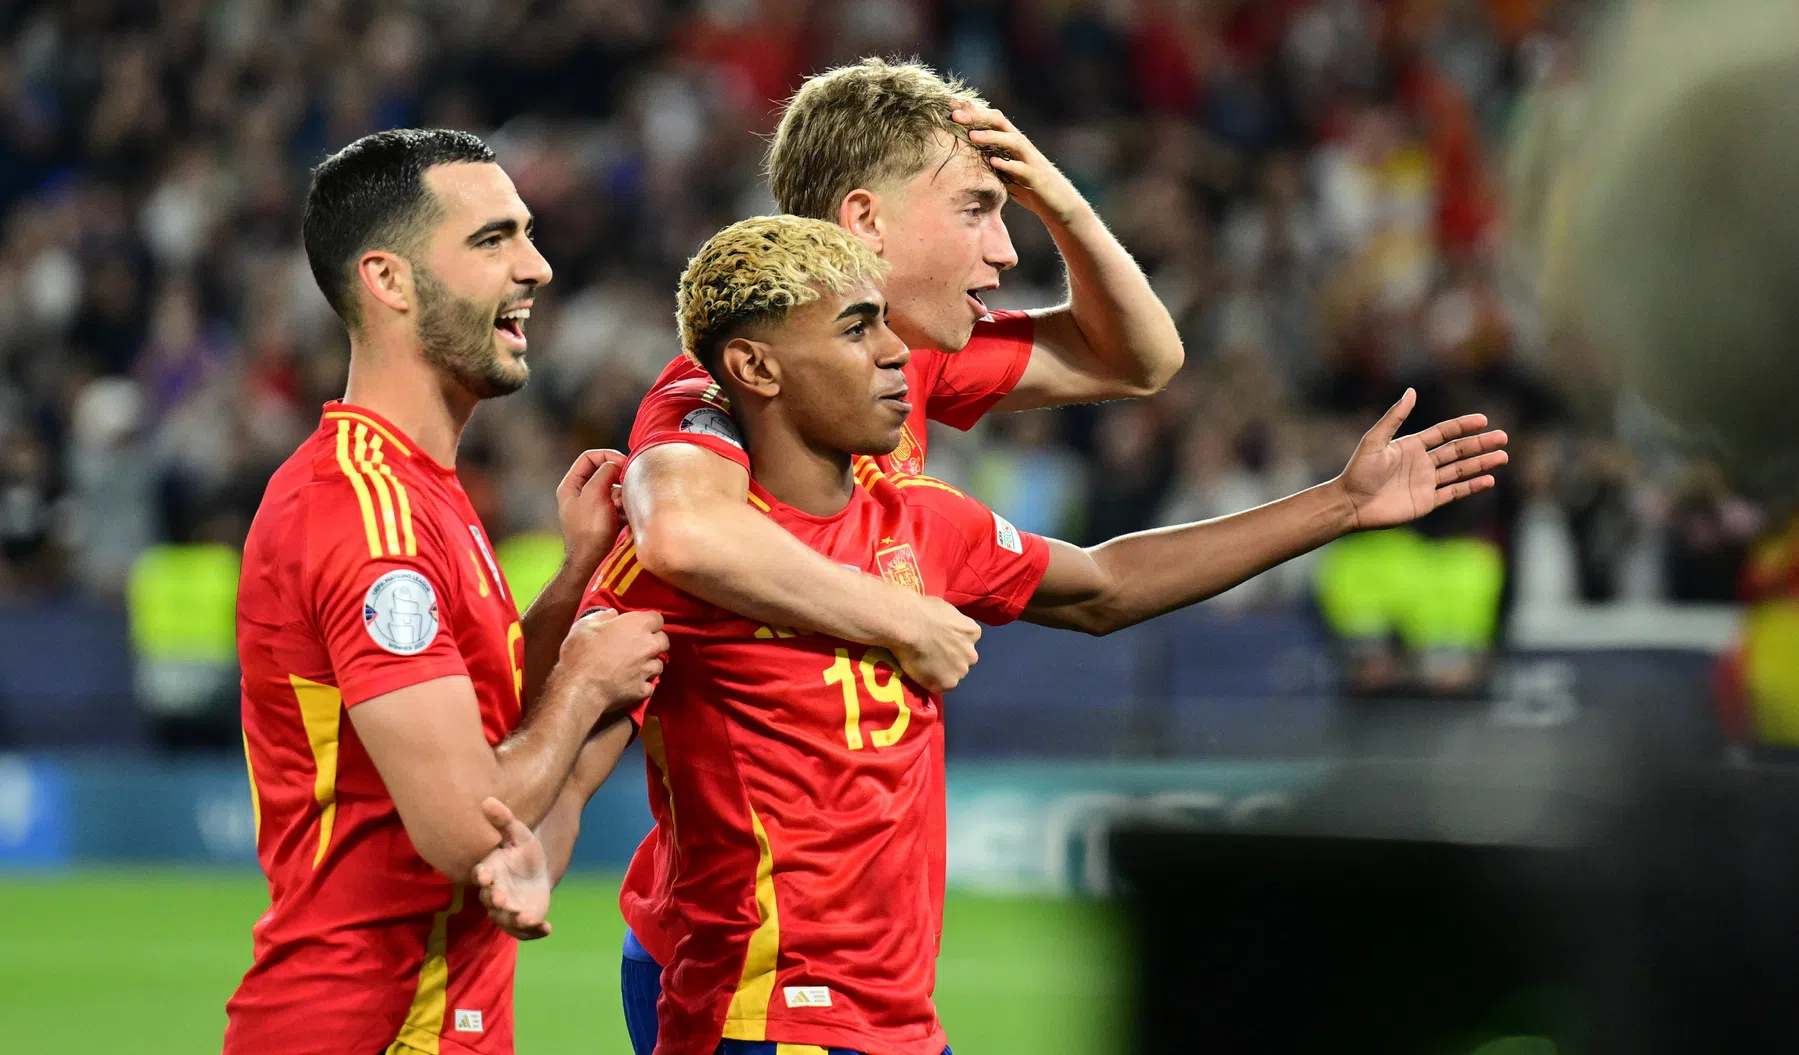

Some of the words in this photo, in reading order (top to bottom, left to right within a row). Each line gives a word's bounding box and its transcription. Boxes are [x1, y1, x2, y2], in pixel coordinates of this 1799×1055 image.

[372, 582, 385, 595] UEFA
[385, 574, 411, 583] NATIONS
[412, 576, 430, 592] LEAGUE
[823, 648, 911, 750] 19
